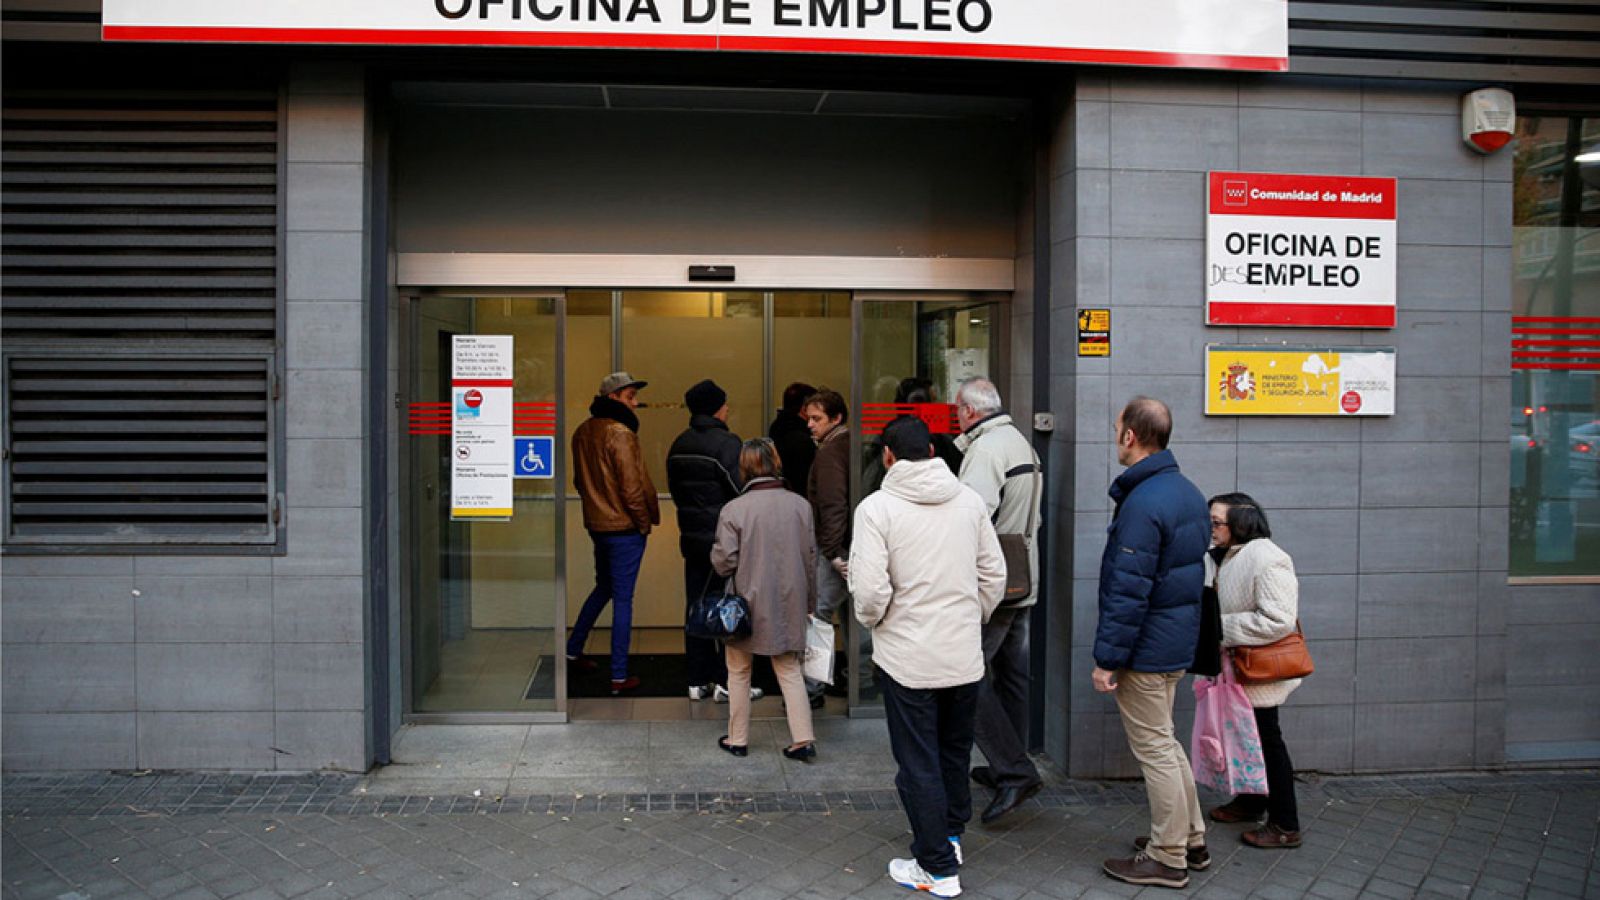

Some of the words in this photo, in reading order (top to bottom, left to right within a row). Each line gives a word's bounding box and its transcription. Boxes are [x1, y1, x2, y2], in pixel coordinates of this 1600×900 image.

[434, 0, 662, 23] OFICINA
[683, 0, 752, 25] DE
[773, 0, 993, 33] EMPLEO
[1250, 188, 1319, 202] Comunidad
[1322, 190, 1338, 202] de
[1341, 191, 1383, 204] Madrid
[1225, 232, 1337, 257] OFICINA
[1345, 236, 1381, 258] DE
[1247, 263, 1361, 287] EMPLEO
